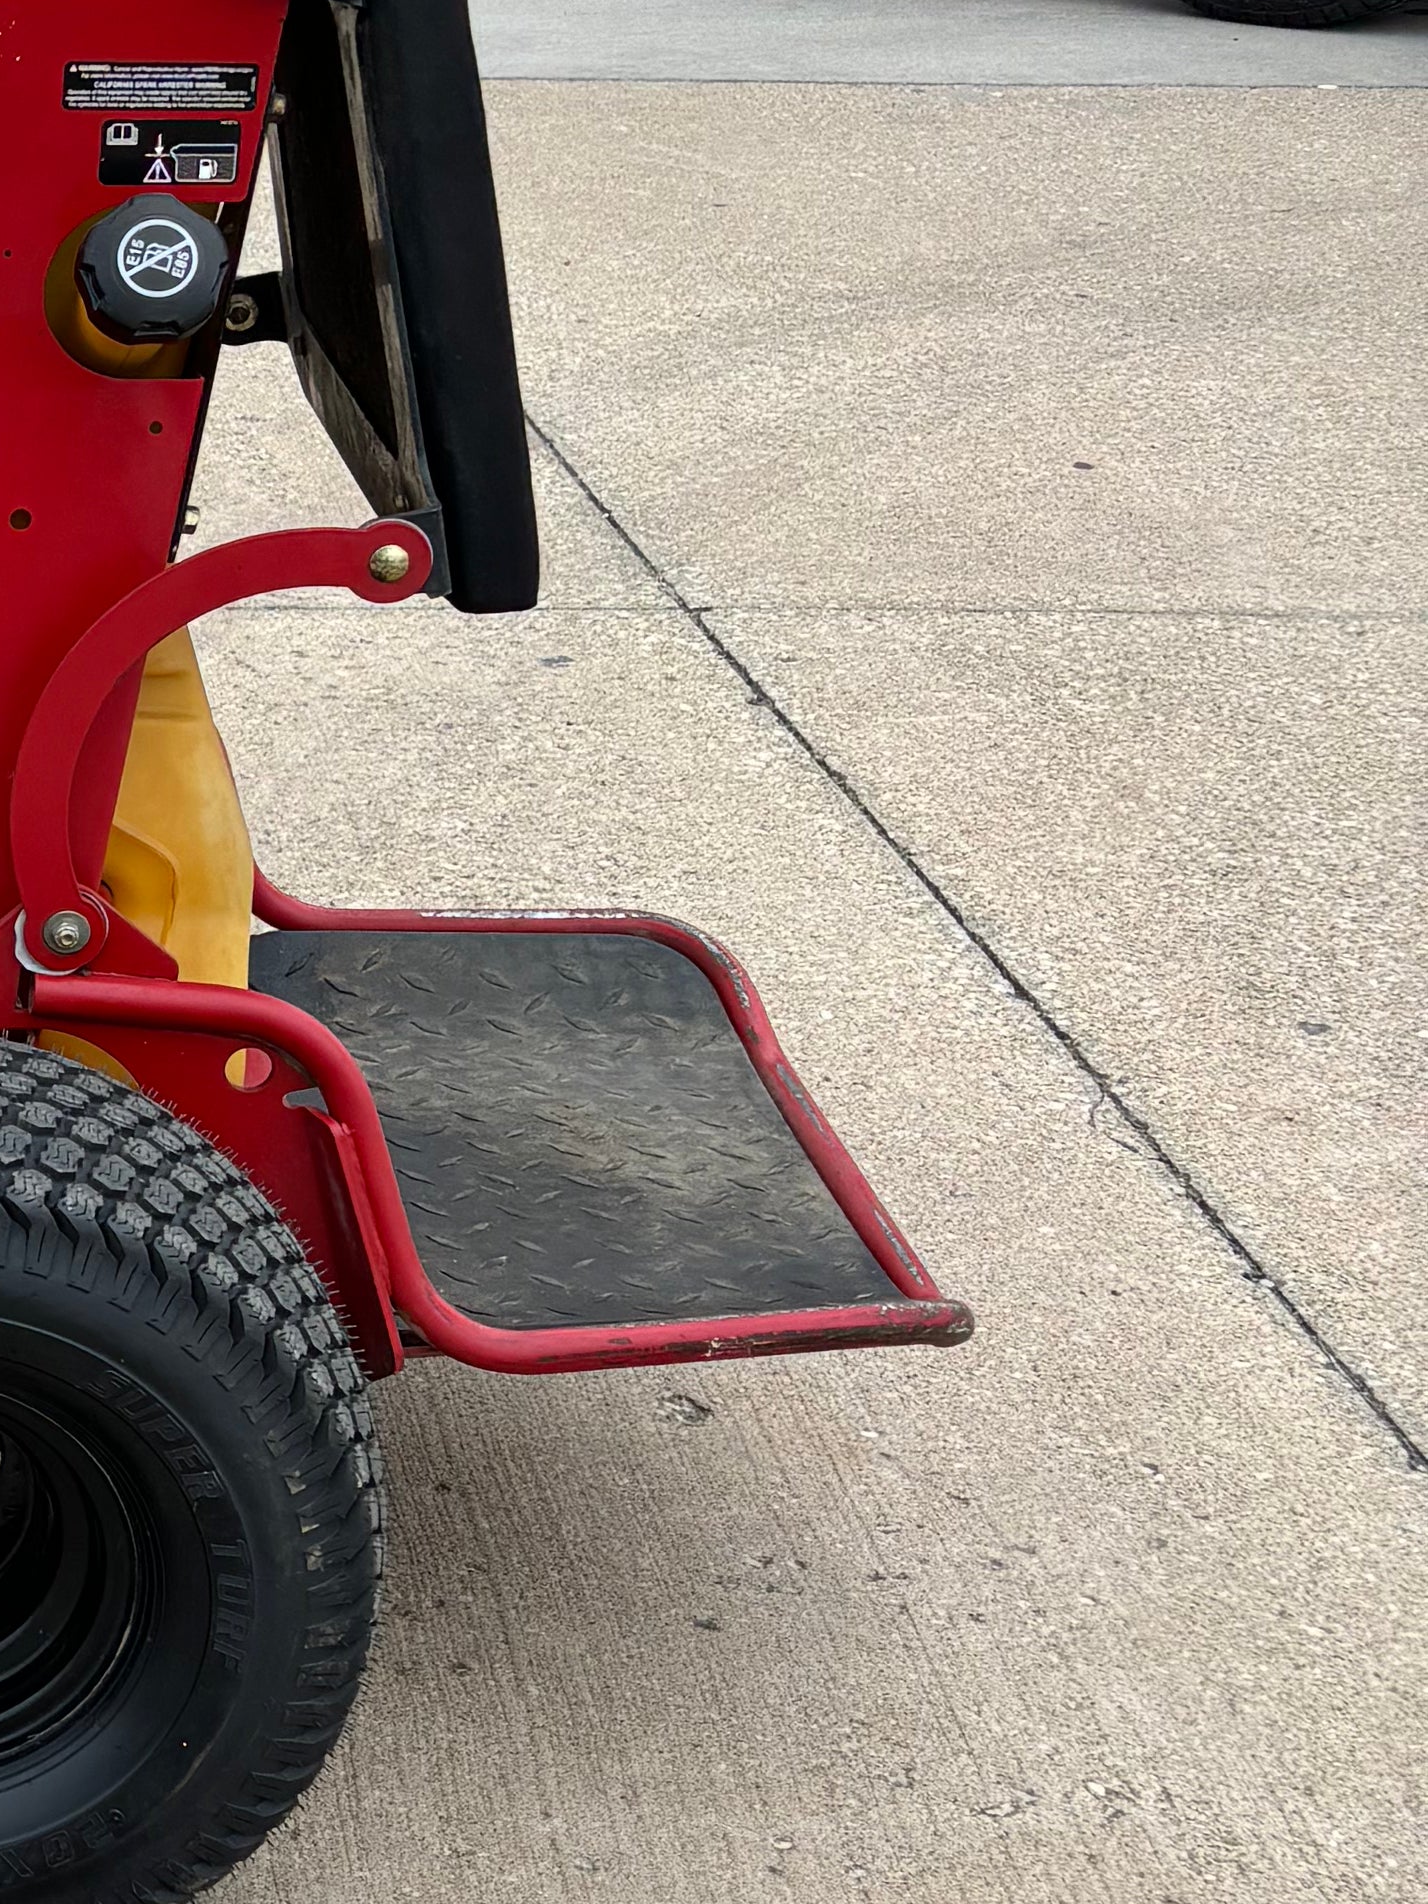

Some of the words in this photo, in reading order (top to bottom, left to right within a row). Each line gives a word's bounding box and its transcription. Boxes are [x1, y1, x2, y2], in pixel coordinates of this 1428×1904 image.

[126, 238, 145, 266] E15
[85, 1368, 227, 1514] SUPER
[208, 1536, 258, 1677] TURF
